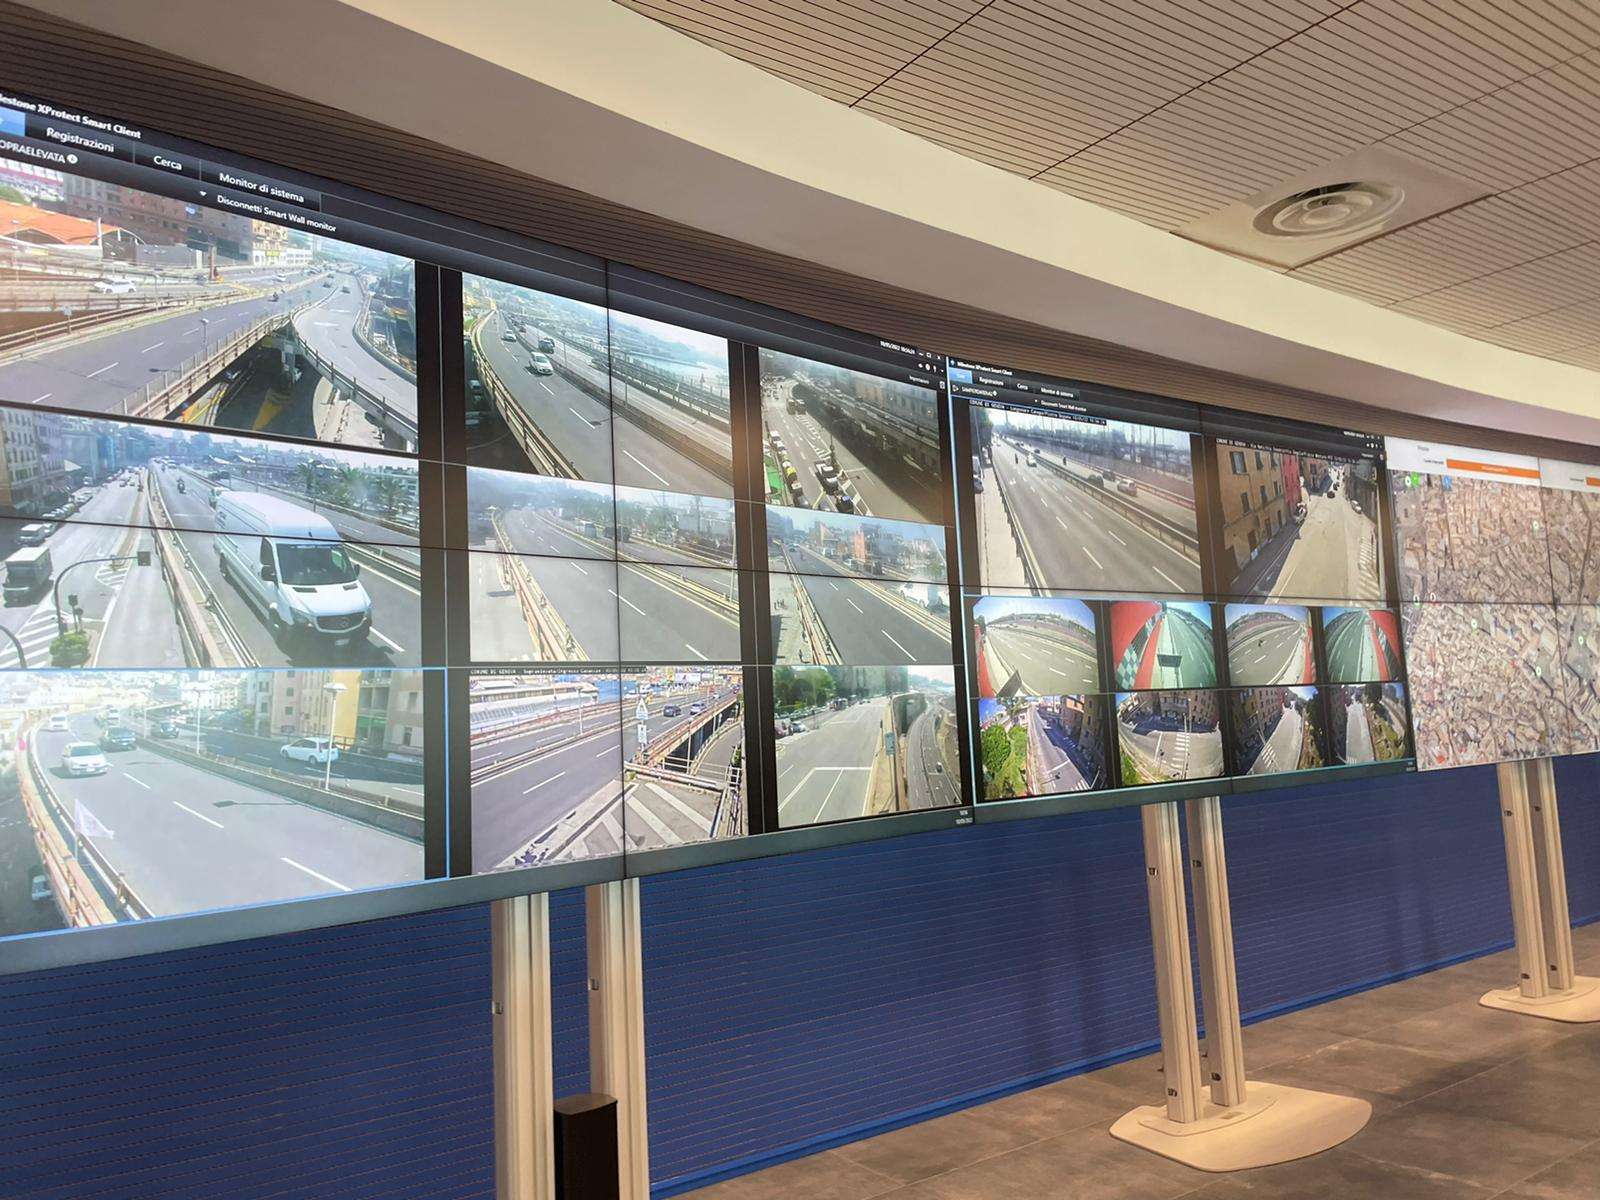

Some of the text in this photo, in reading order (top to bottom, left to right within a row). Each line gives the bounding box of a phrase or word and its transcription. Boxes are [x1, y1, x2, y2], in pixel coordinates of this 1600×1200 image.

[37, 104, 80, 123] XProtect
[82, 115, 111, 133] Smart
[113, 123, 142, 140] Client
[46, 127, 114, 153] Registrazioni
[153, 155, 183, 171] Cerca
[219, 172, 304, 203] Monitor di sistema
[217, 195, 337, 233] Disconnetti Smart Wall monitor
